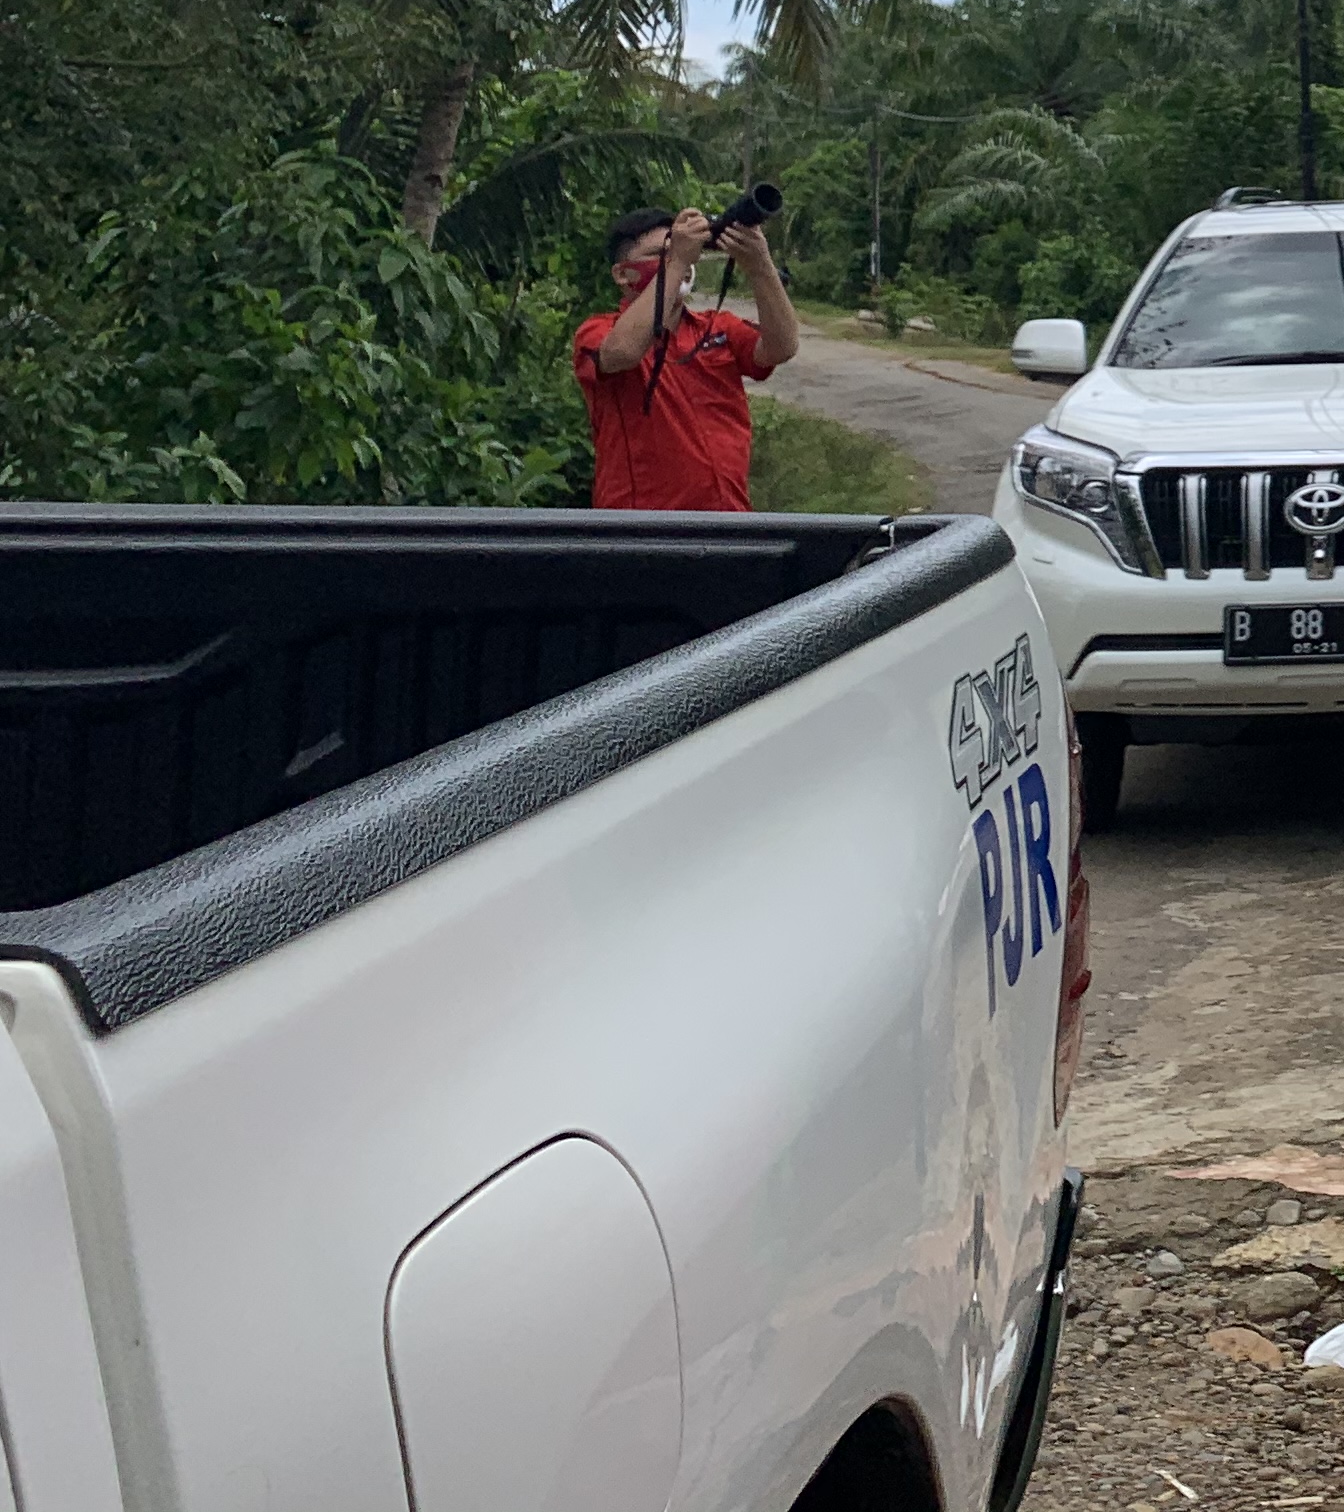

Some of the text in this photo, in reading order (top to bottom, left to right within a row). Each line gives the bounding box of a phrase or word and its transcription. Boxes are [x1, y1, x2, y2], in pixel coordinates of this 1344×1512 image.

[1234, 611, 1250, 642] B
[1290, 609, 1323, 639] 88
[972, 762, 1062, 1023] PJR
